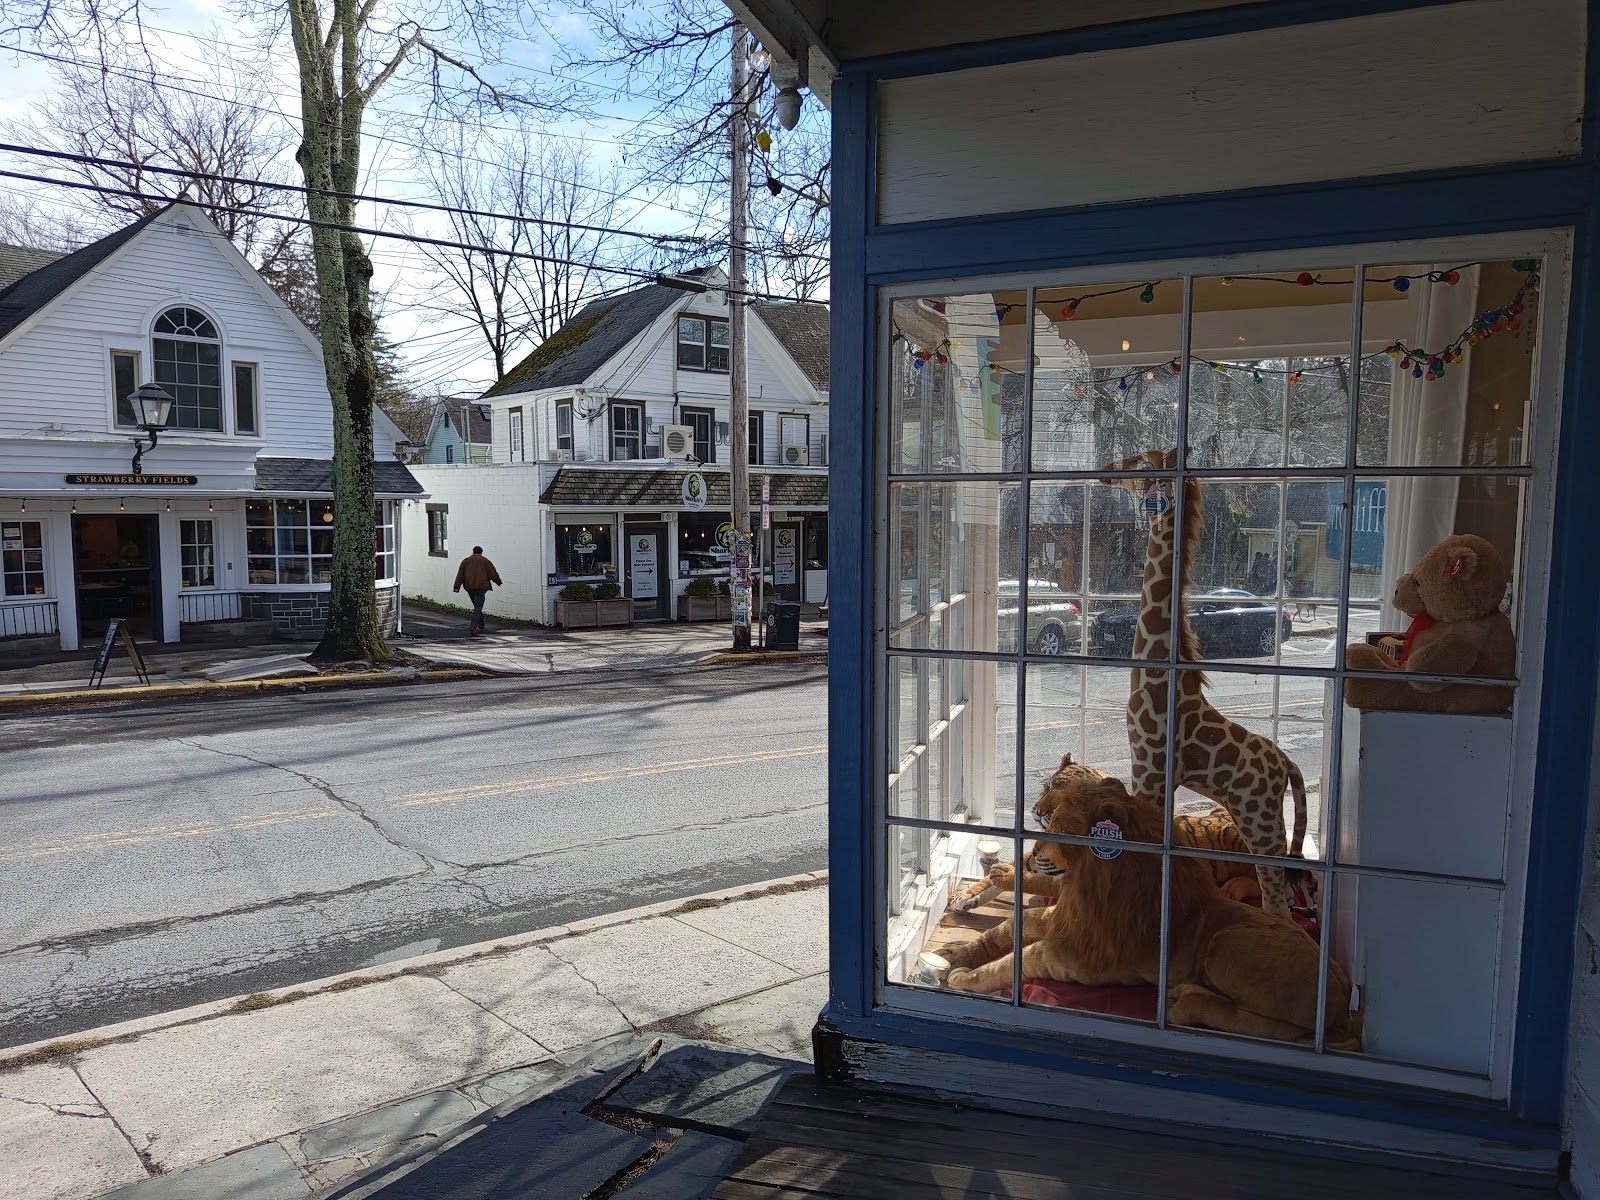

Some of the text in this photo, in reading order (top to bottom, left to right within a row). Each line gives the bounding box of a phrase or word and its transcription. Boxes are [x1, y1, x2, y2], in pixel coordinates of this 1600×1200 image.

[75, 475, 189, 484] STRAWBERRY FIELDS
[1091, 826, 1122, 840] PLUSH
